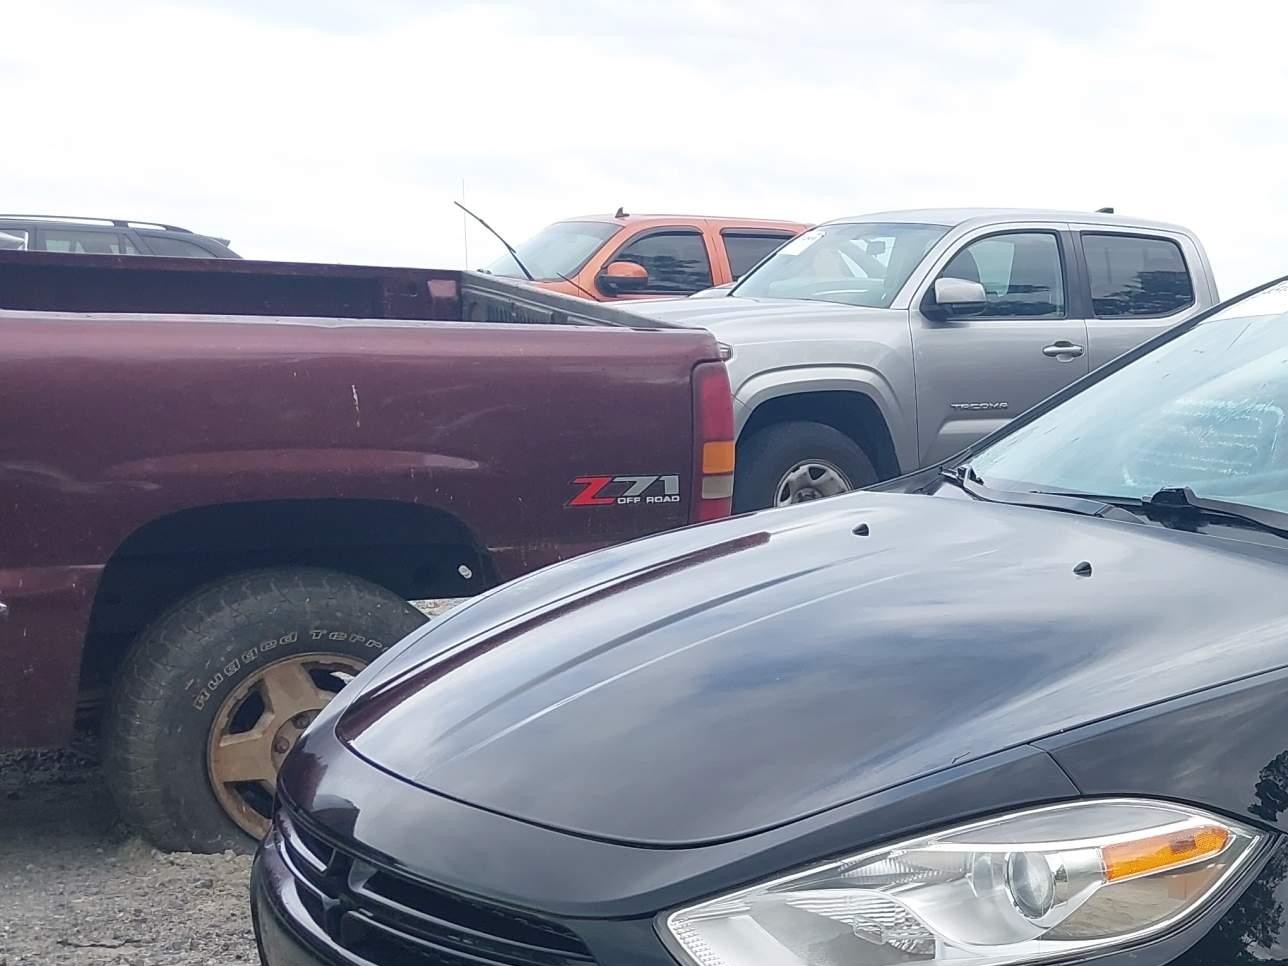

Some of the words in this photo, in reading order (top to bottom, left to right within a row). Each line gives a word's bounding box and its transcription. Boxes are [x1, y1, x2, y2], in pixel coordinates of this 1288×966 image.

[950, 401, 1009, 411] TACOMA
[568, 475, 680, 505] Z71
[617, 496, 641, 505] OFF
[645, 495, 680, 504] ROAD
[193, 631, 299, 712] Rugged
[310, 629, 391, 651] Terr
